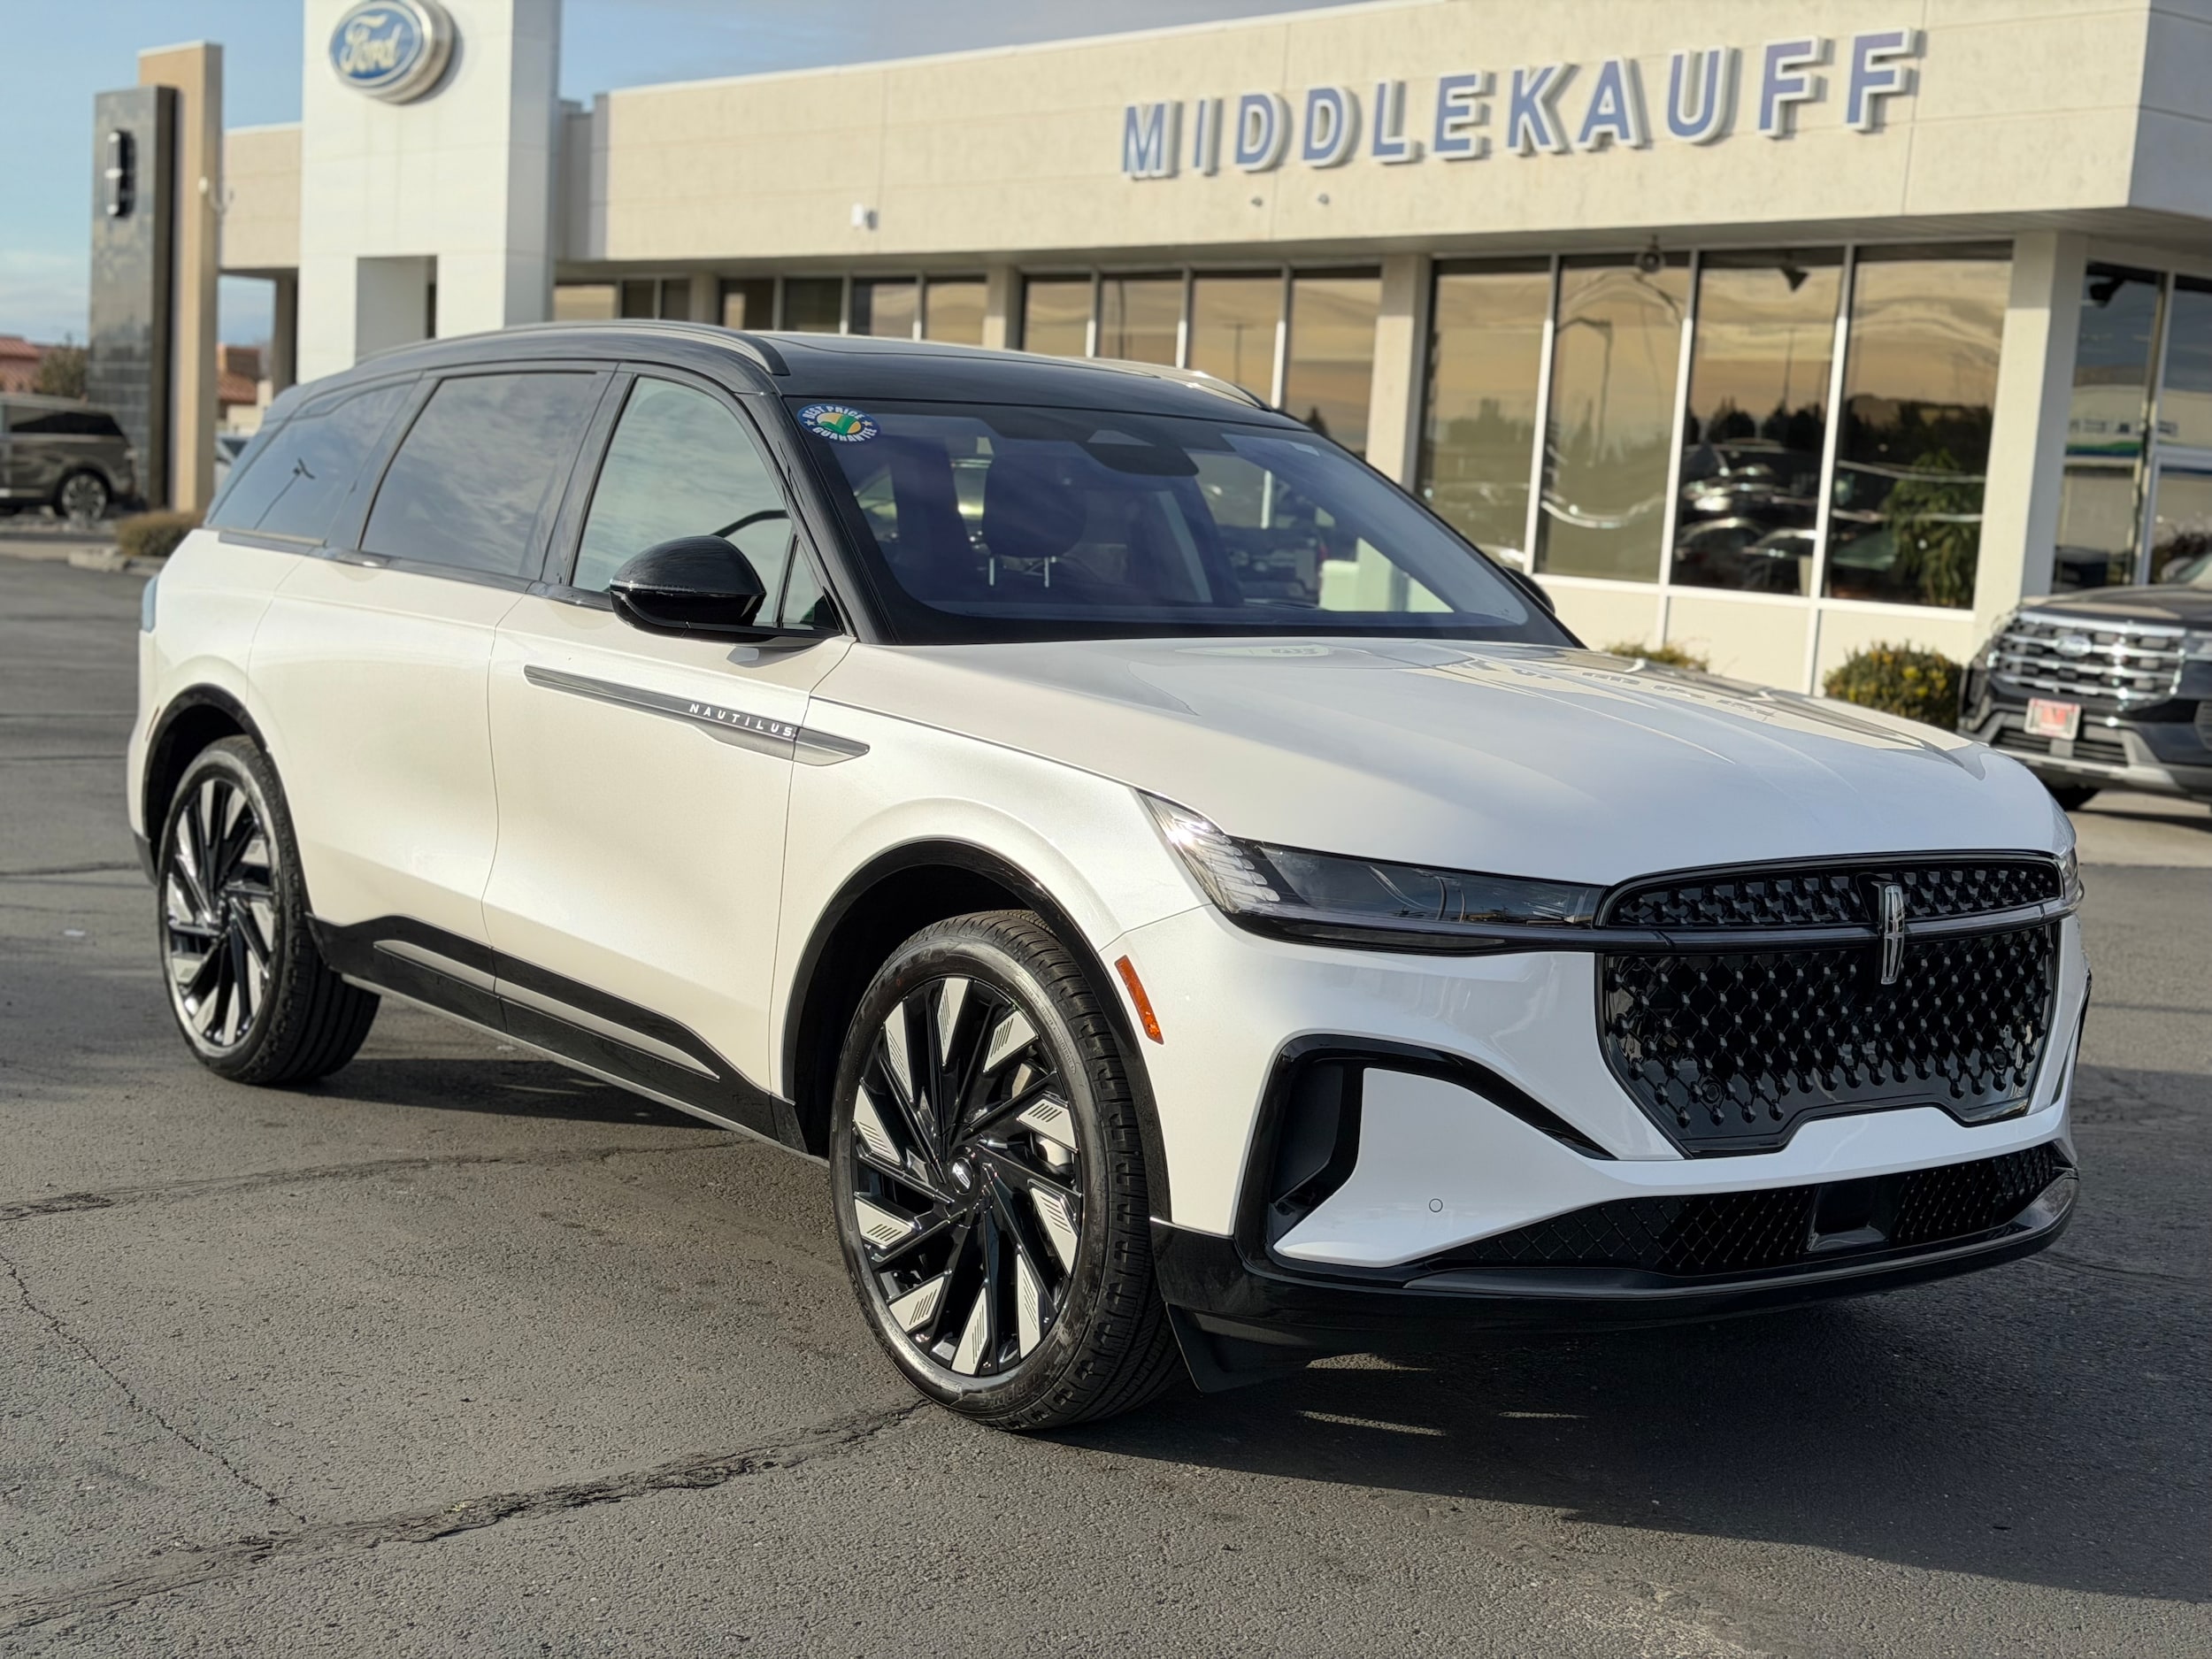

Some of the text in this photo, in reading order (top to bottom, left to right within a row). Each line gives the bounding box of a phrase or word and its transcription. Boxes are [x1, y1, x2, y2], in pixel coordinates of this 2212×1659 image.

[339, 13, 403, 74] Ford
[1121, 27, 1918, 180] MIDDLEKAUFF
[802, 405, 865, 420] BEST PRICE
[811, 426, 878, 442] GUARANTEE
[689, 703, 794, 737] NAUTILUS
